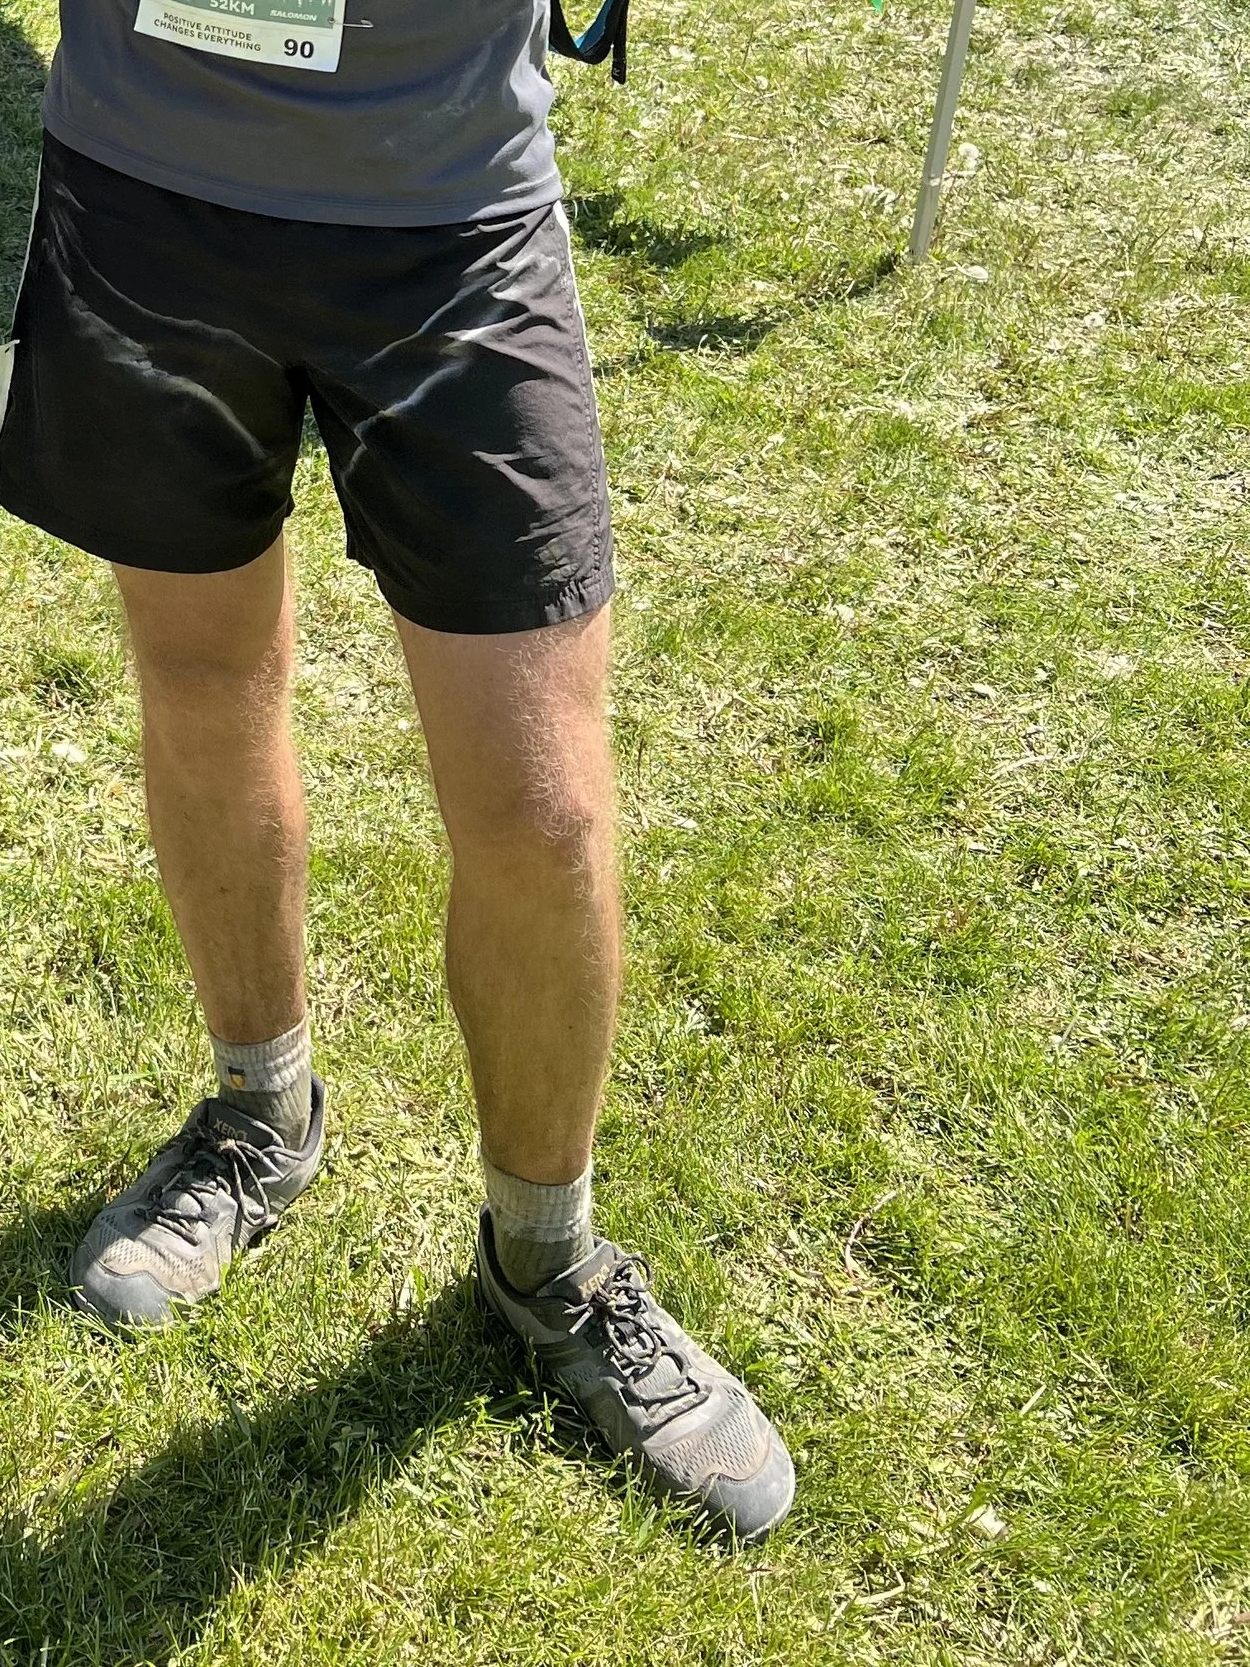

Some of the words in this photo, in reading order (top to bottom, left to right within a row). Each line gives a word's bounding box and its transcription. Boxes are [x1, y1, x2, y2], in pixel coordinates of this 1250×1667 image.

[163, 12, 202, 31] POSITIVE
[203, 24, 253, 41] ATTITUDE
[270, 9, 318, 22] SALOMON
[154, 18, 196, 38] CHANGES
[197, 31, 261, 52] EVERYTHING
[283, 38, 315, 59] 90
